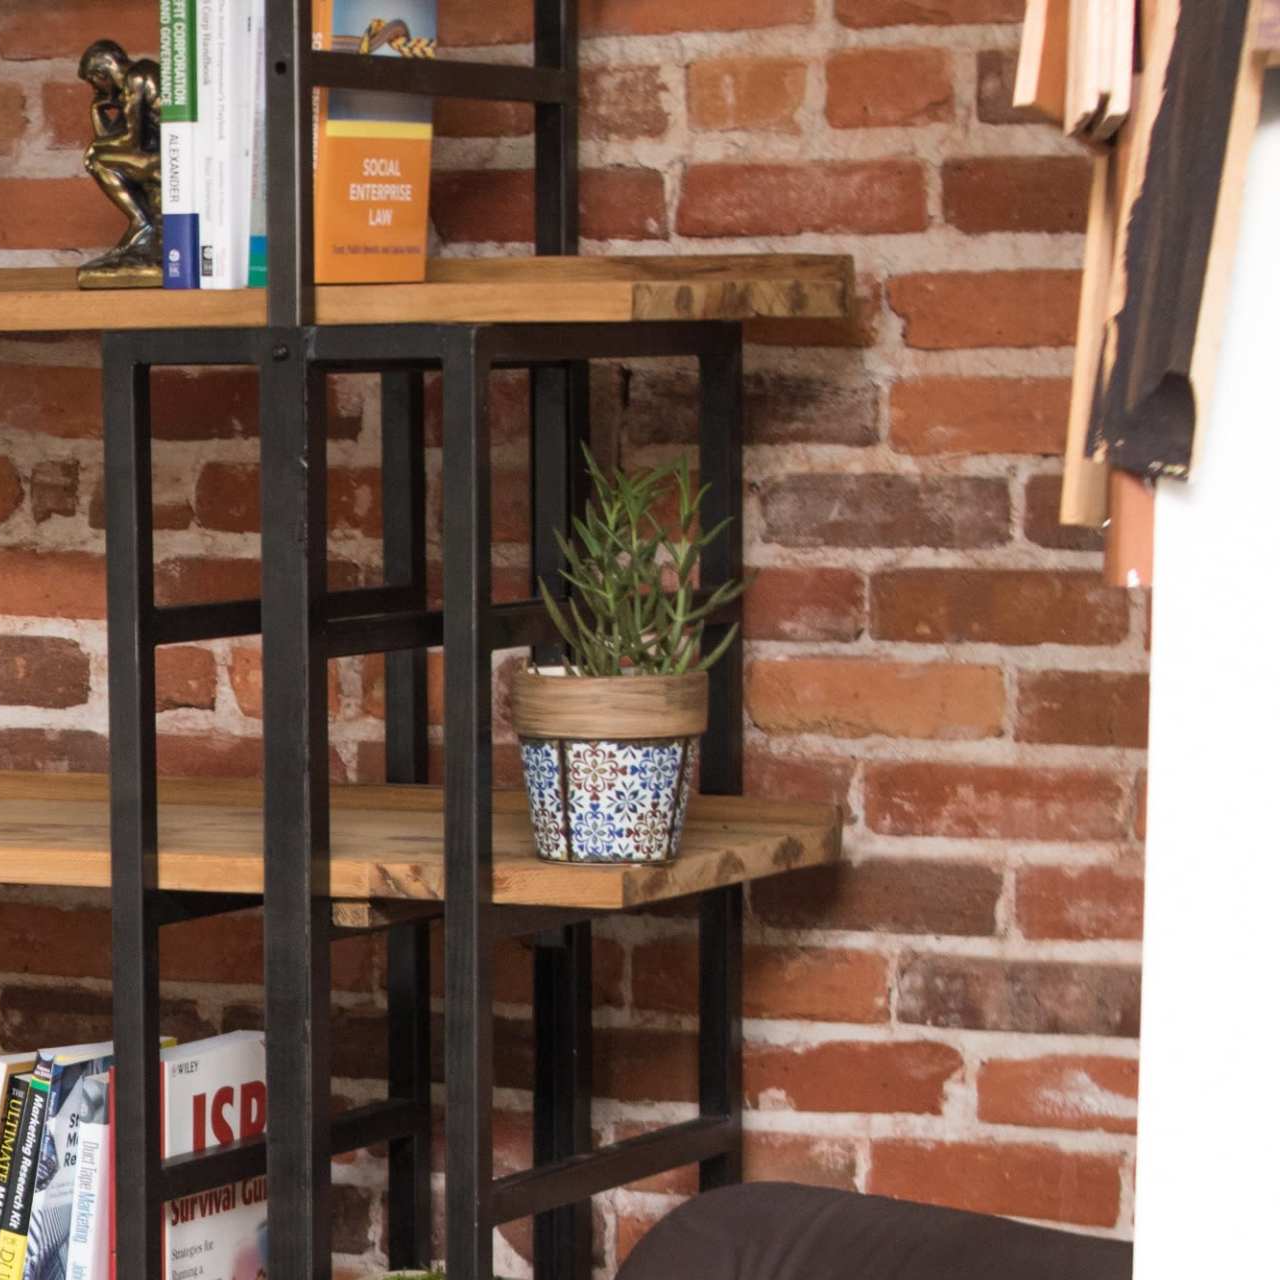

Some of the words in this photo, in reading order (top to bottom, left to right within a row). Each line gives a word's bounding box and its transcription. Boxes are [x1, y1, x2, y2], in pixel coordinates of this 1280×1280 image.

[160, 27, 172, 105] GOVERNANCE
[174, 22, 186, 105] CORPORATION
[203, 33, 212, 86] Handbook
[169, 134, 180, 203] ALEXANDER
[362, 157, 401, 177] SOCIAL
[349, 183, 413, 201] ENTERPRISE
[368, 208, 393, 226] LAW
[177, 1060, 199, 1075] WILEY
[22, 1094, 43, 1157] Marketing
[193, 1080, 267, 1154] ISP
[80, 1140, 100, 1165] Duct
[13, 1157, 32, 1210] Research
[78, 1166, 97, 1191] Tape
[9, 1209, 22, 1230] Kit
[72, 1190, 96, 1244] Marketing
[170, 1183, 237, 1227] Survival
[172, 1242, 203, 1260] Strategies
